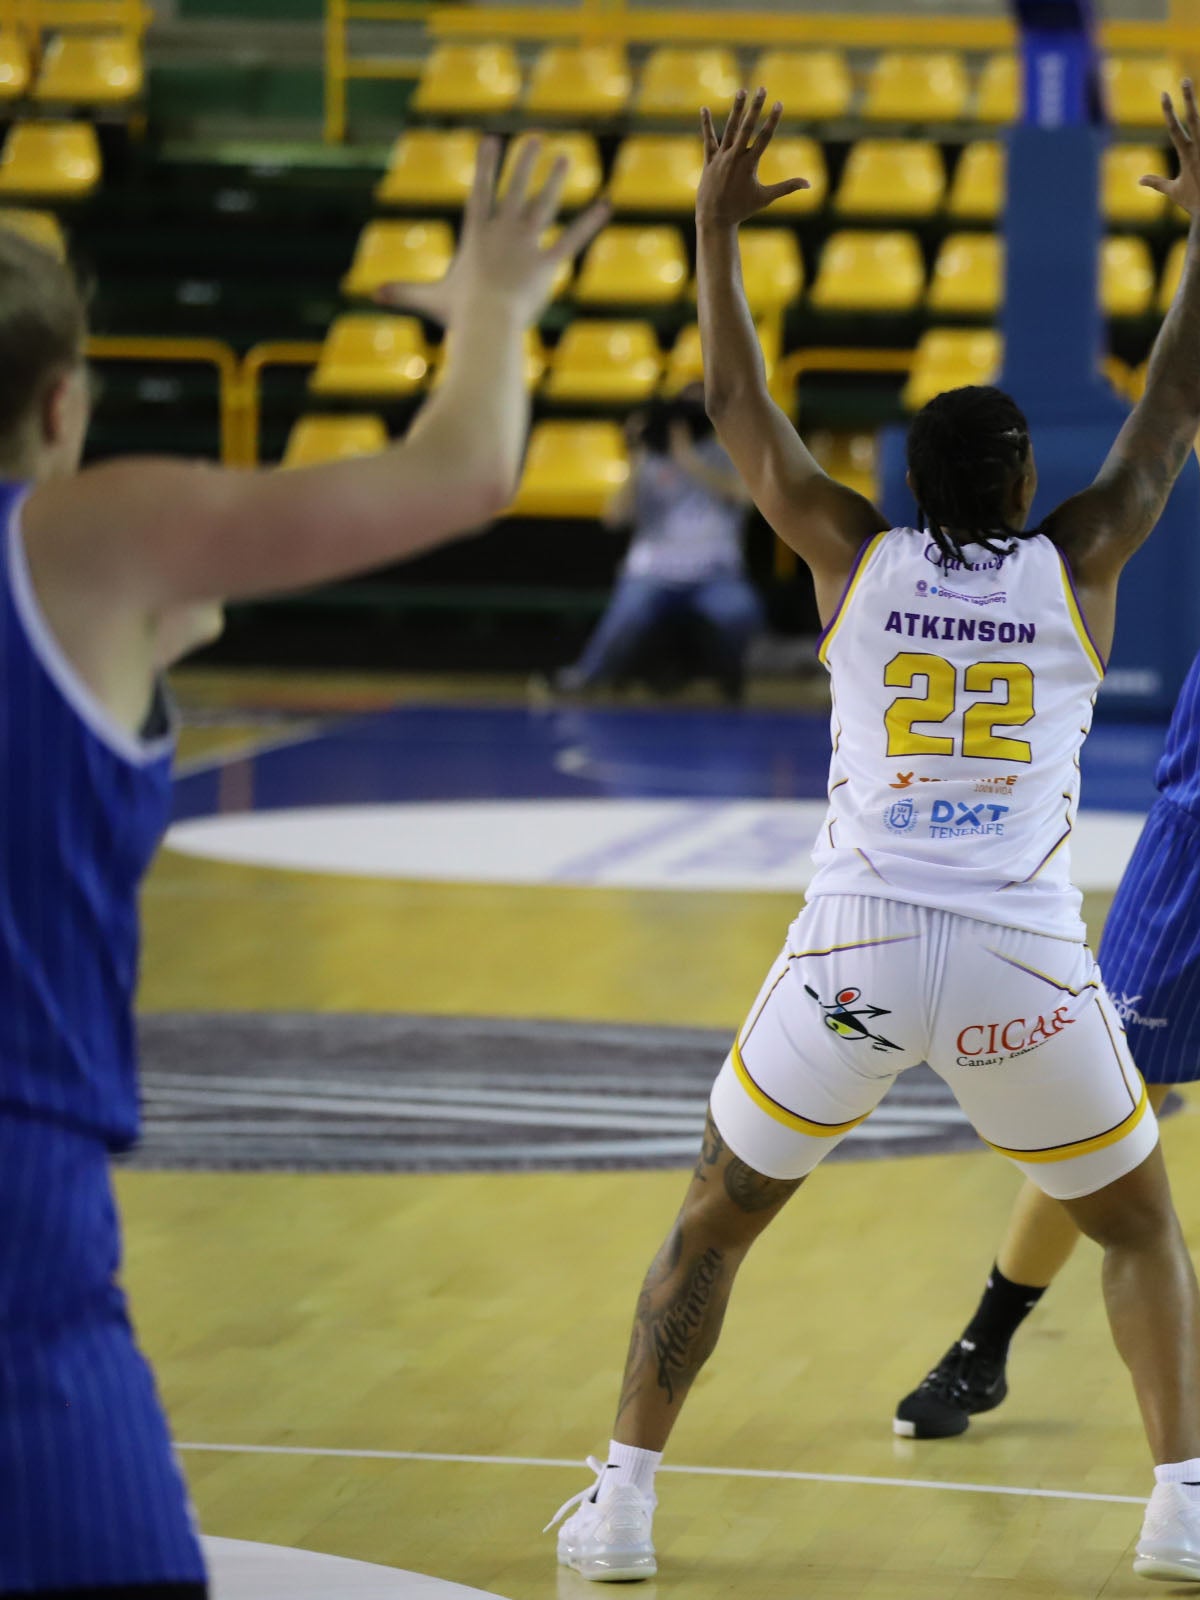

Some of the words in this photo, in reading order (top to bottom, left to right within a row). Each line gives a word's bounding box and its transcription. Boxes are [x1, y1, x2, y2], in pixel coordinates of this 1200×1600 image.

[884, 610, 1037, 645] ATKINSON
[883, 651, 1038, 766] 22
[930, 799, 1010, 827] DXT
[929, 823, 1005, 839] TENERIFE
[956, 1006, 1077, 1057] CICAR
[956, 1056, 1005, 1067] Canary
